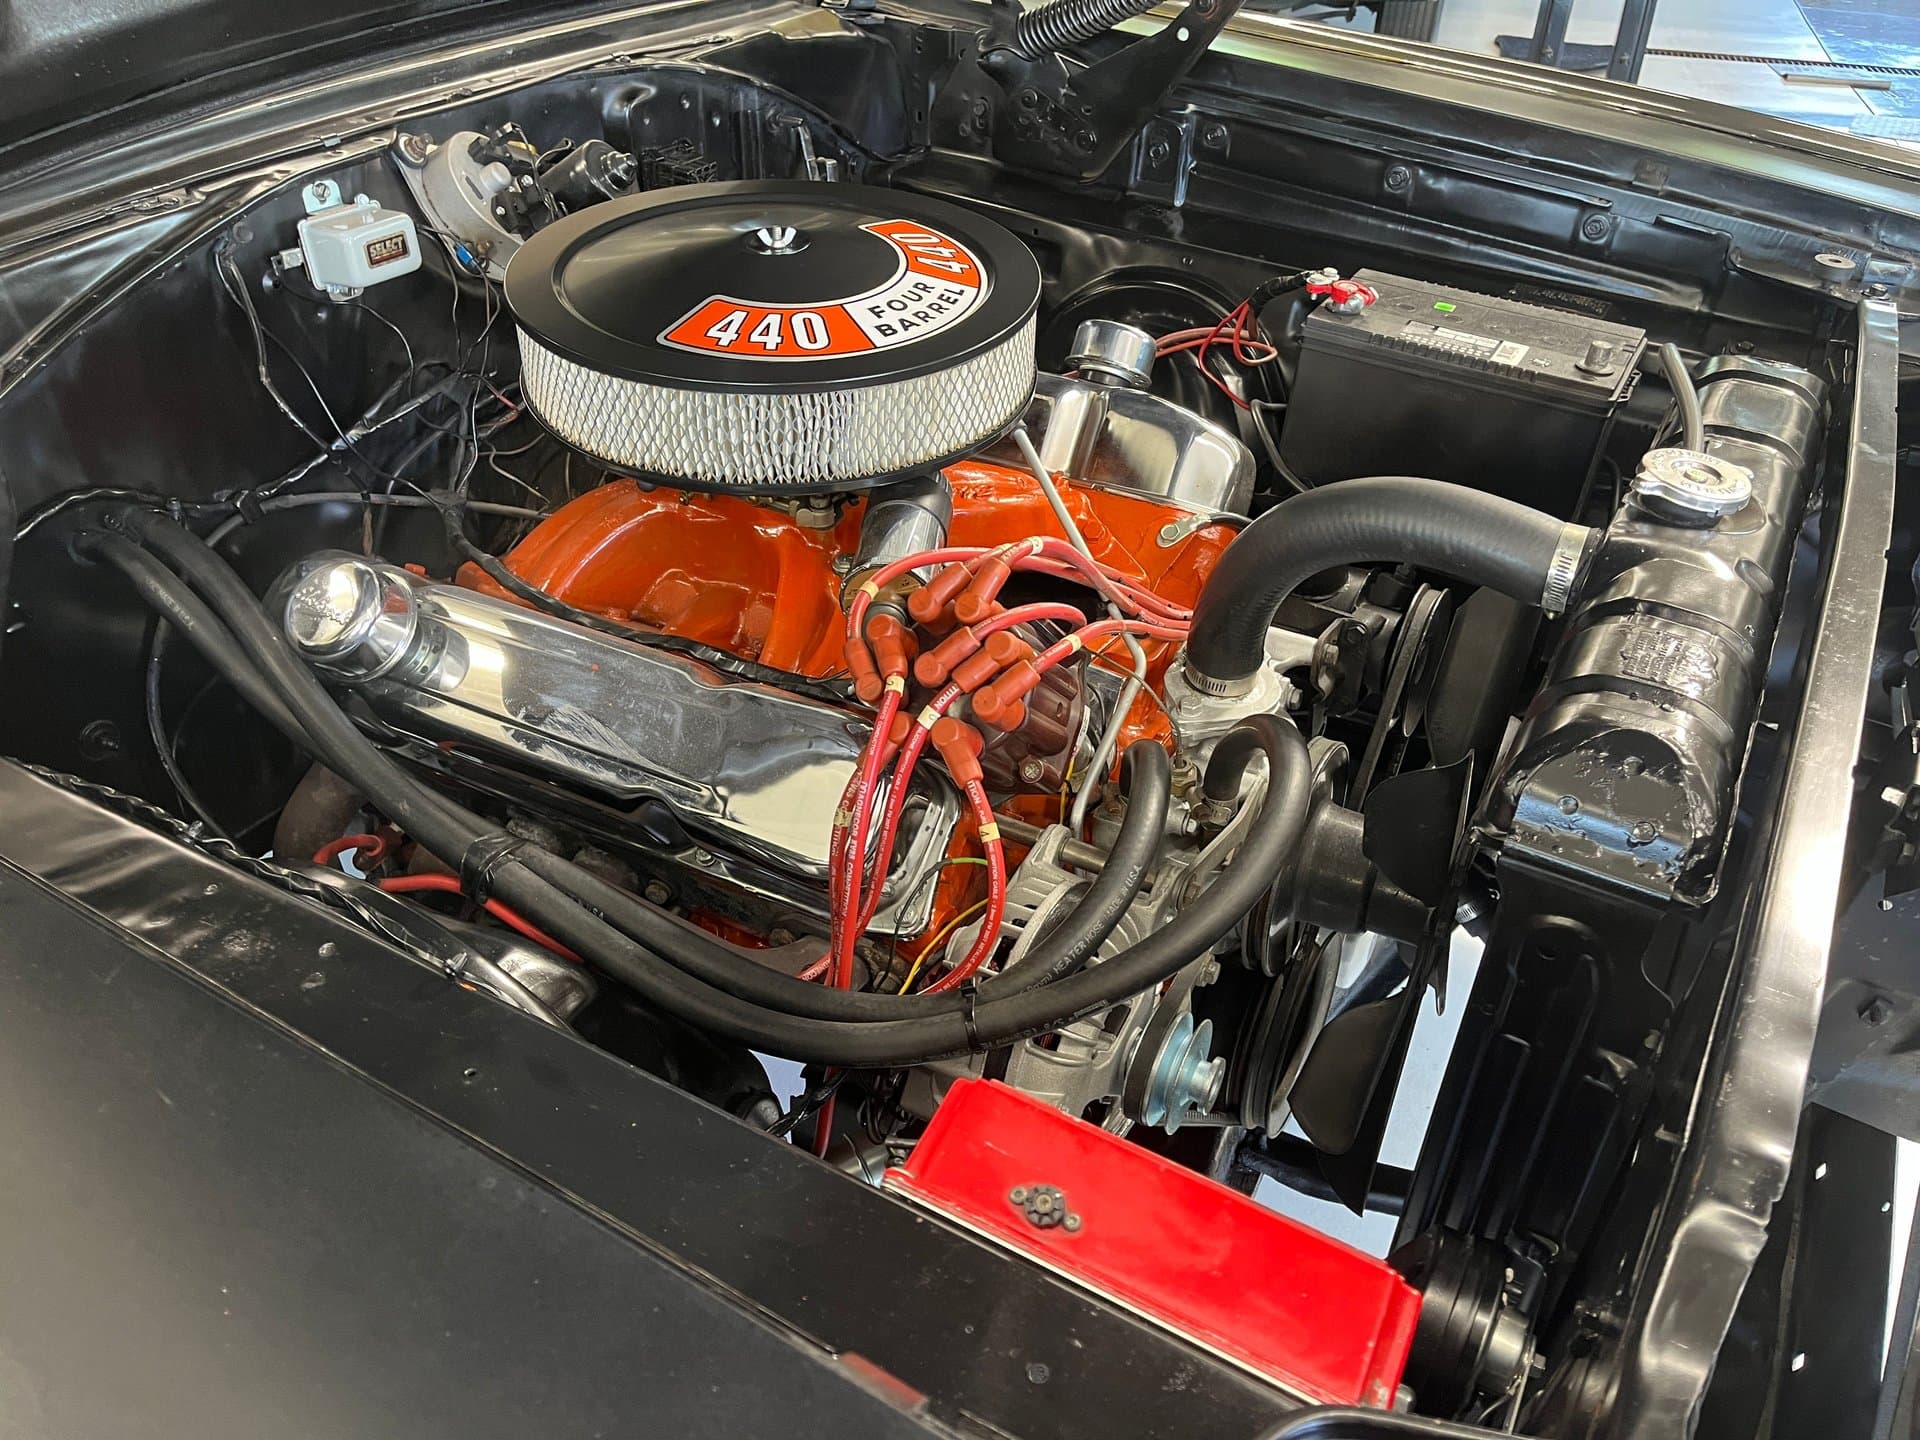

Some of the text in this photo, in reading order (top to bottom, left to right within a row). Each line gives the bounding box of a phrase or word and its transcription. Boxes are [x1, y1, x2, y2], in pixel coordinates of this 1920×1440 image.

[369, 236, 403, 258] SELECT
[889, 231, 971, 275] 440
[867, 281, 936, 319] FOUR
[874, 286, 966, 338] BARREL
[705, 310, 831, 350] 440
[1052, 940, 1087, 975] HEATER
[1084, 920, 1105, 944] HOSE
